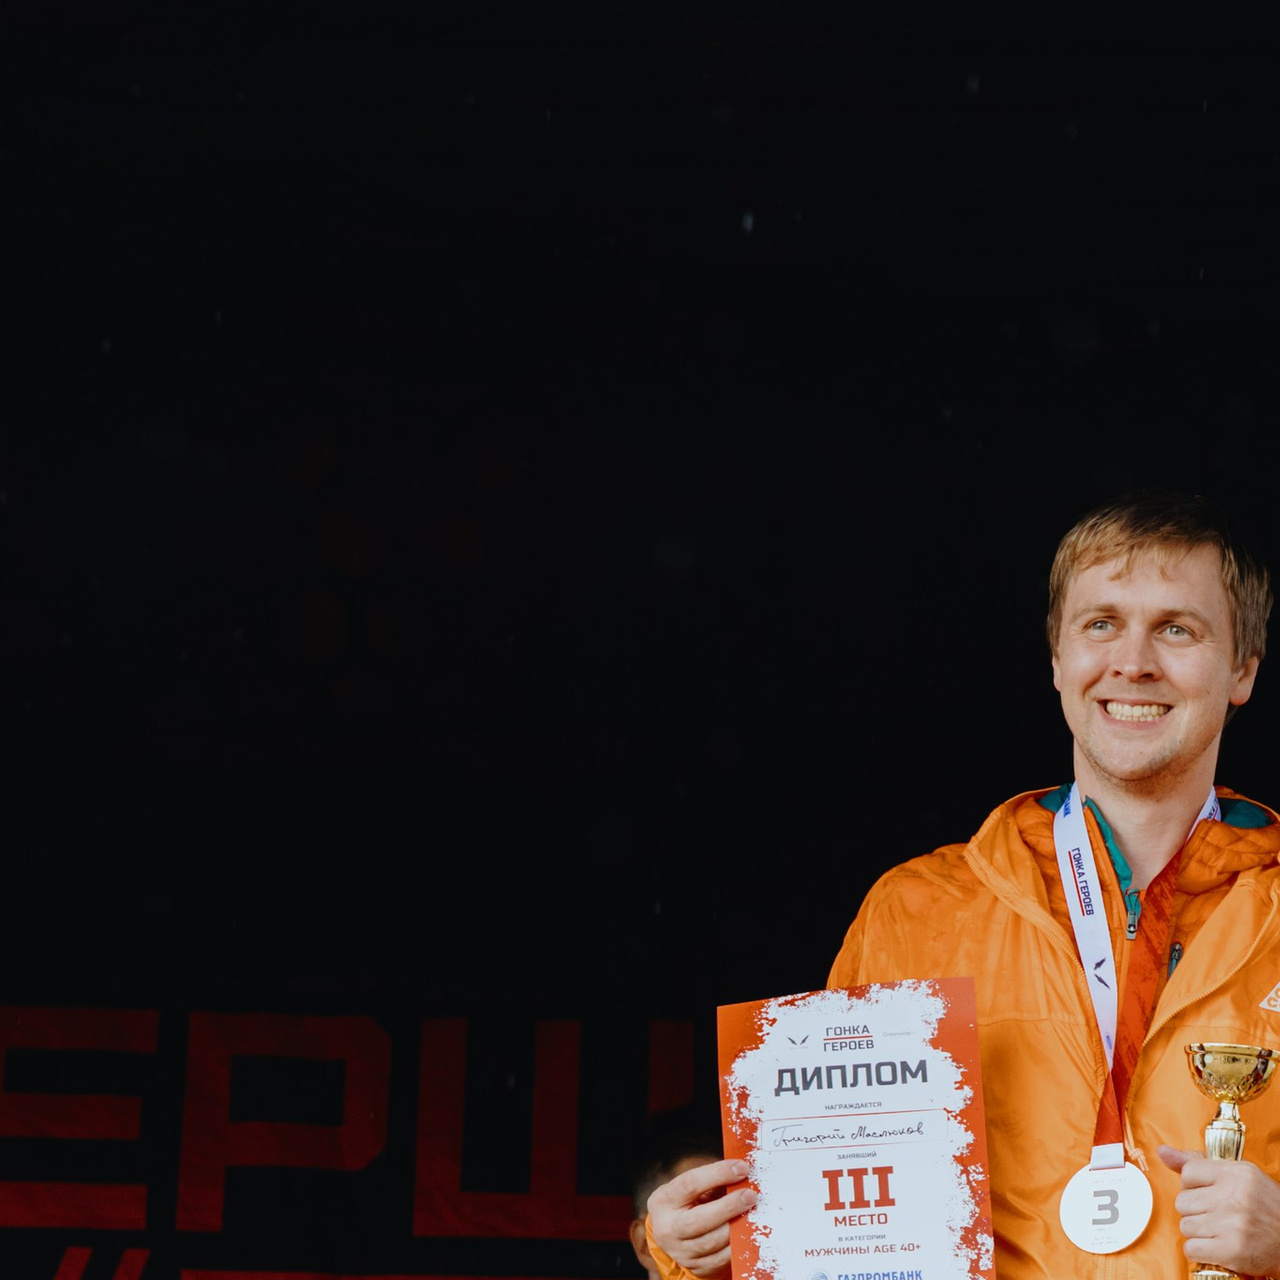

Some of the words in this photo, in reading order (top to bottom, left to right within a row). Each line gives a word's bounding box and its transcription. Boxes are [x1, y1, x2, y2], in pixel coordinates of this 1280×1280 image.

[1072, 847, 1085, 878] ГОНКА
[1079, 880, 1094, 915] ГЕРОЕВ
[826, 1025, 870, 1036] ГОНКА
[823, 1039, 874, 1052] ГЕРОЕВ
[774, 1059, 928, 1097] ДИПЛОМ
[824, 1101, 882, 1111] НАГРАЖДАЕТСЯ
[837, 1151, 877, 1160] ЗАНЯВШИЙ
[822, 1166, 896, 1211] III
[1092, 1189, 1119, 1225] 3
[834, 1213, 888, 1227] МЕСТО
[845, 1234, 886, 1242] КАТЕГОРИИ
[804, 1246, 870, 1257] МУЖЧИНЫ
[873, 1244, 897, 1254] AGE
[900, 1243, 921, 1252] 40+
